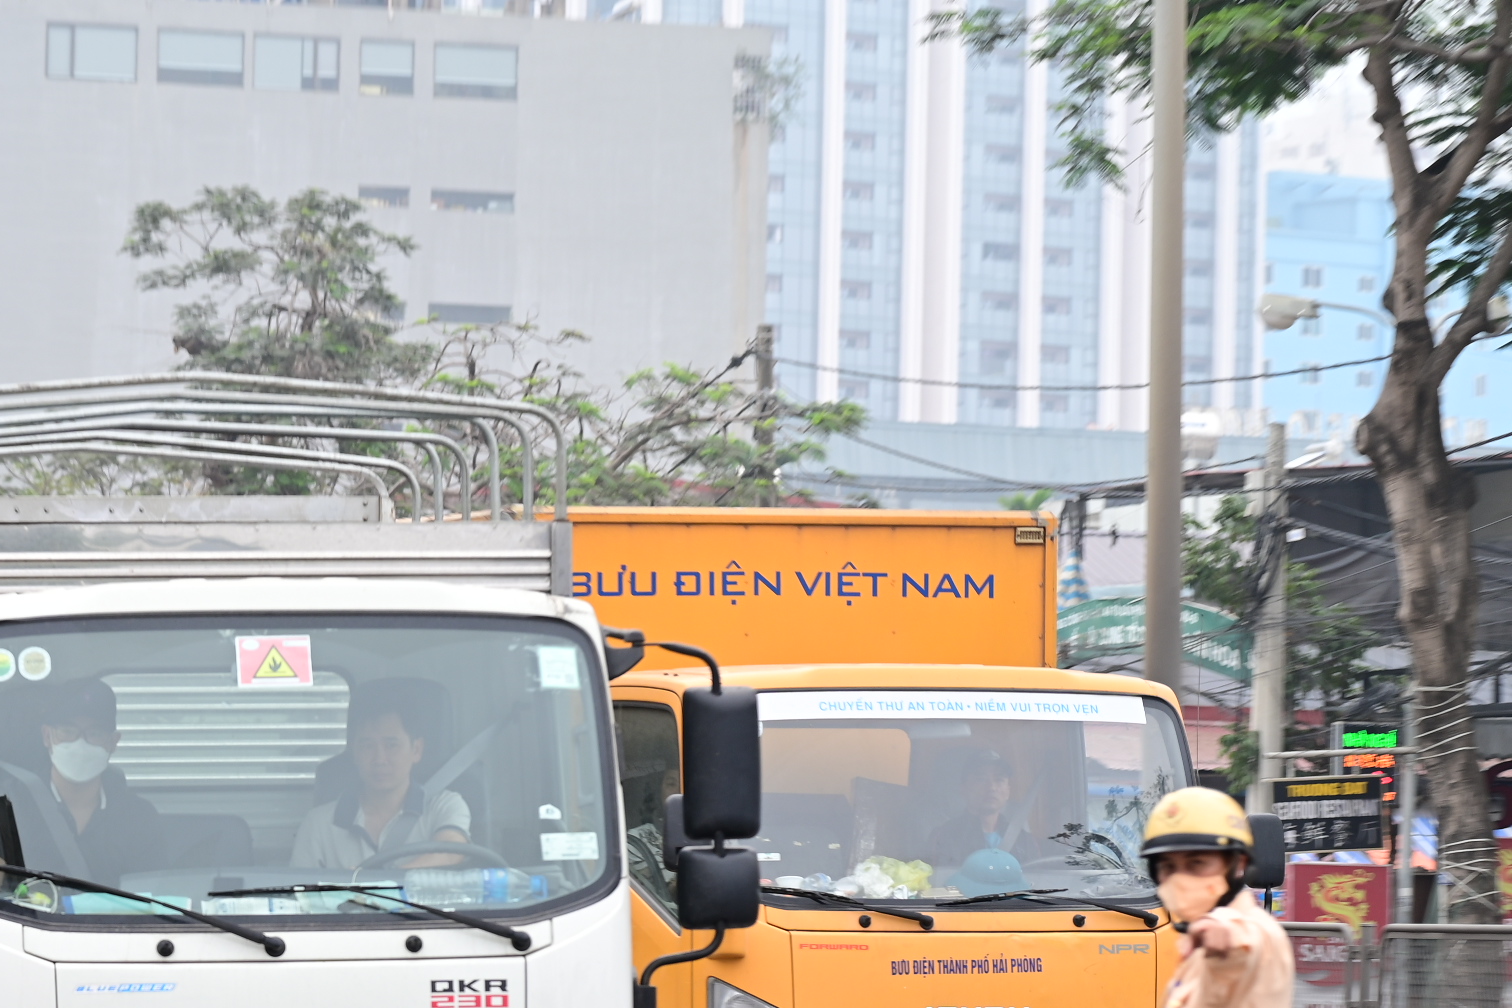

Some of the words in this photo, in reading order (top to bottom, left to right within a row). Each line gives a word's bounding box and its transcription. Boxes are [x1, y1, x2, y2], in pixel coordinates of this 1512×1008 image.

[573, 564, 657, 597] BƯU
[674, 560, 782, 605] ĐIỆN
[795, 561, 888, 606] VIỆT
[902, 572, 994, 599] NAM
[908, 701, 925, 711] AN
[930, 699, 964, 711] TOÀN
[1009, 702, 1031, 712] VUI
[799, 943, 869, 951] FORWARD
[1098, 944, 1150, 955] NPR
[913, 956, 935, 979] ĐIỆN
[937, 957, 968, 975] THÀNH
[971, 953, 989, 975] PHỐ
[992, 953, 1008, 974] HẢI
[1010, 955, 1043, 973] PHÒNG
[431, 979, 508, 993] QKR
[431, 994, 509, 1008] 230
